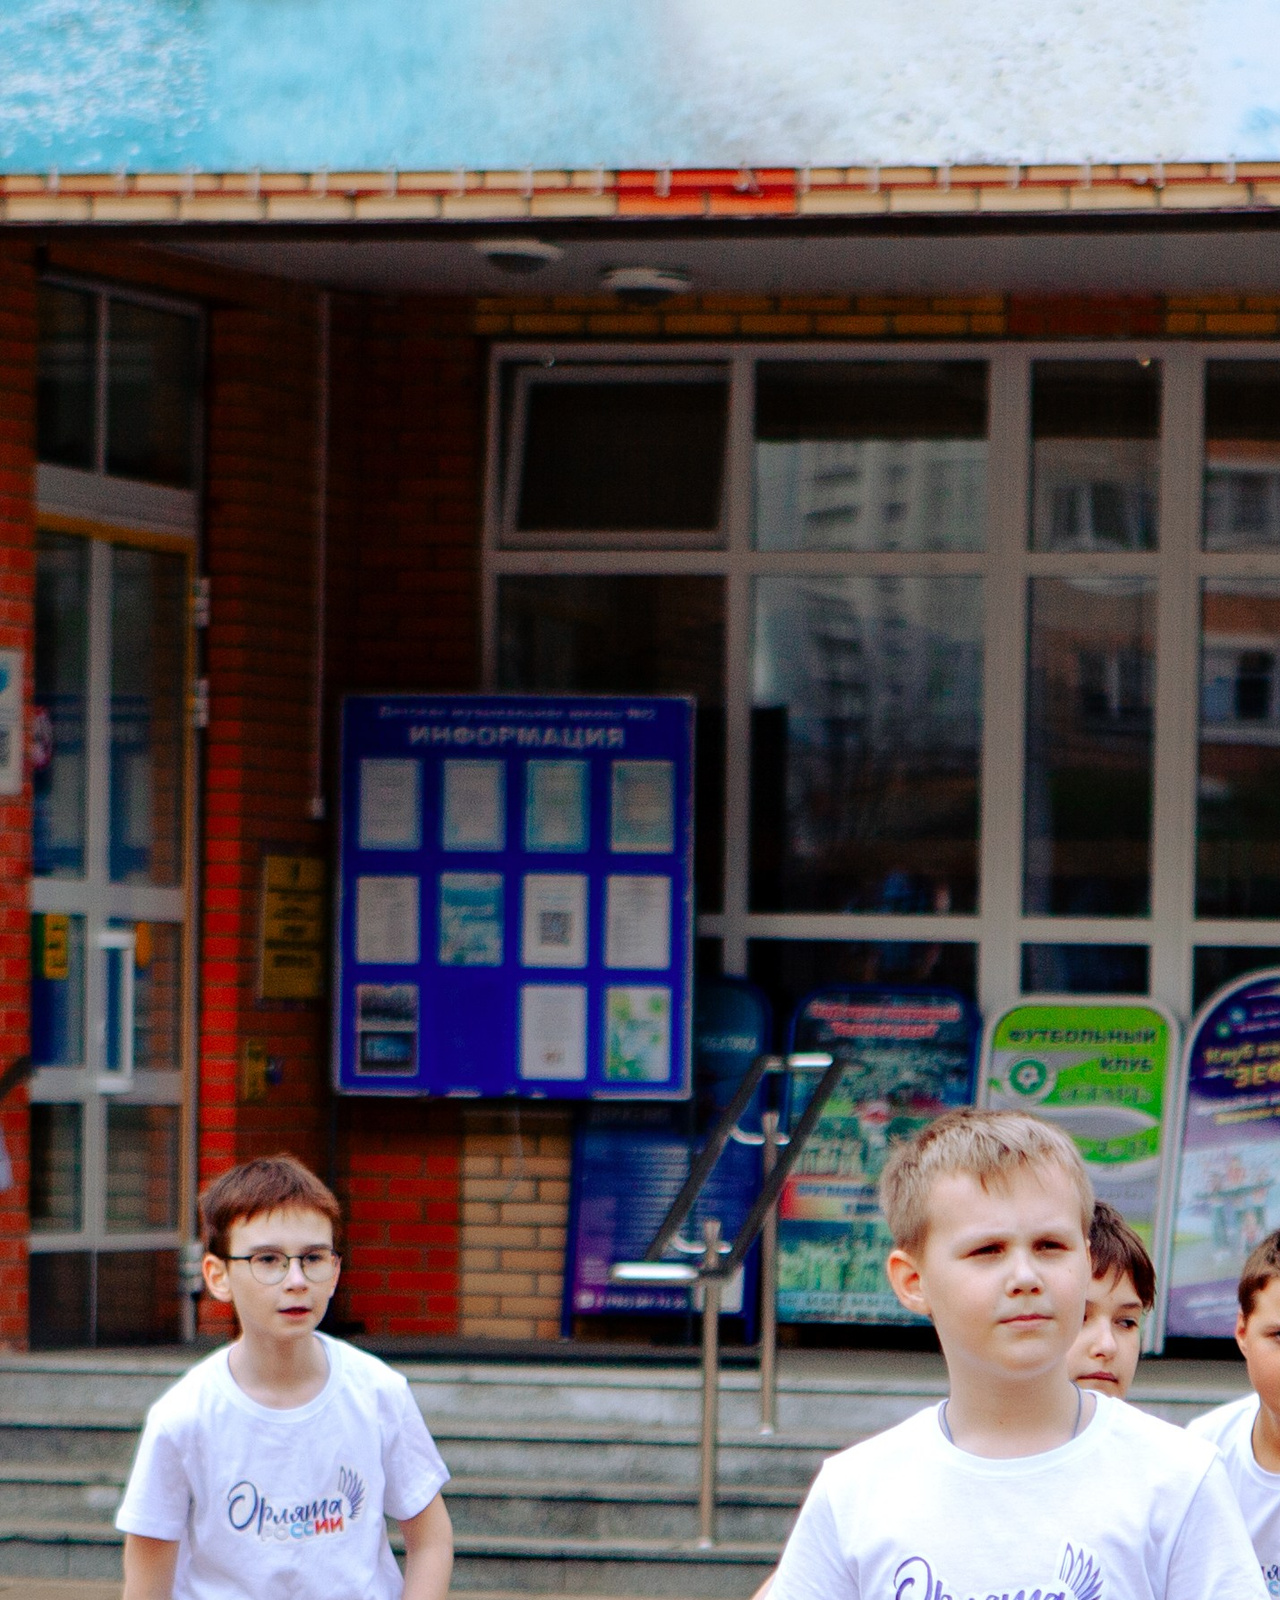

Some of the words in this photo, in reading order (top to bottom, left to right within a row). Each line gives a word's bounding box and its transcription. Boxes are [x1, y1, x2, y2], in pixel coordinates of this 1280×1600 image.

[408, 726, 624, 750] ИНФОРМАЦИЯ
[1009, 1028, 1157, 1043] ФУТБОЛЬНЫЙ
[1098, 1057, 1153, 1071] КЛУБ
[228, 1480, 343, 1536] Орлята
[261, 1516, 344, 1541] РОССИИ
